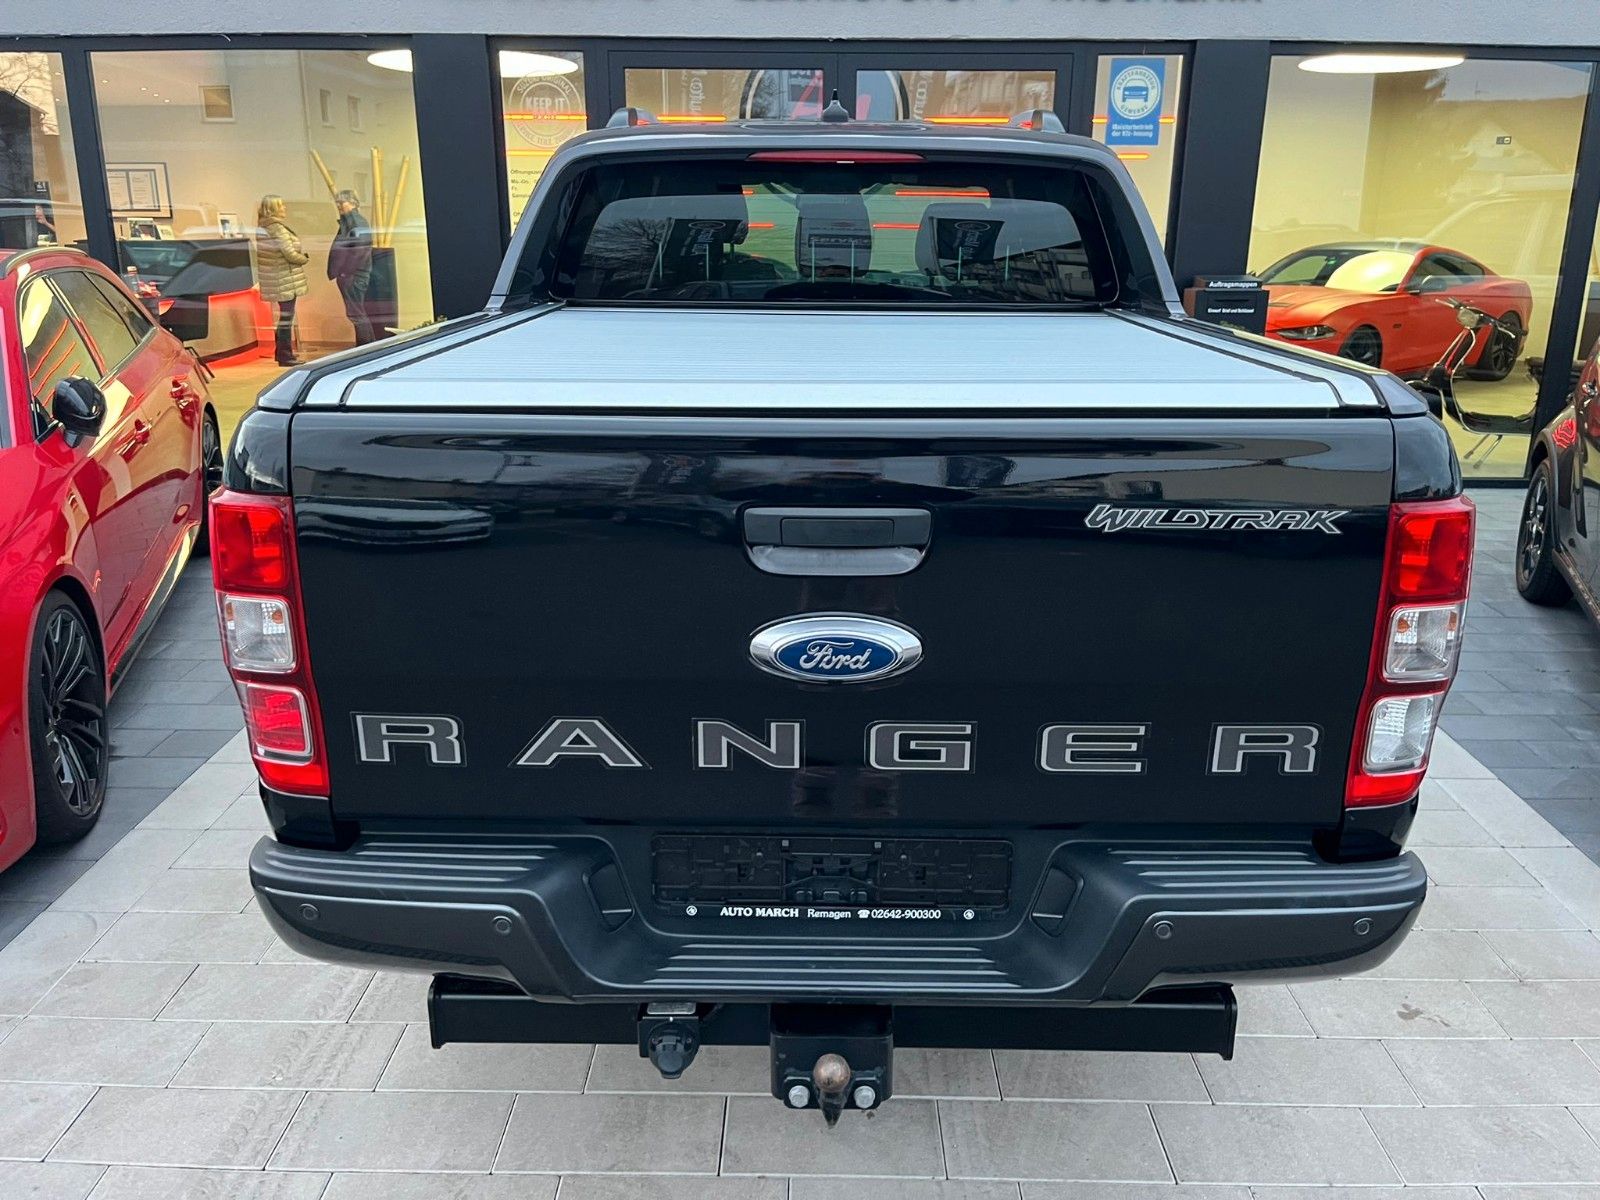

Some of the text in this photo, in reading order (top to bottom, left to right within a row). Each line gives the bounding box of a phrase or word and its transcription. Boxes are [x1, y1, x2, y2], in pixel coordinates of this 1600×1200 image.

[525, 96, 552, 113] KEEP
[1084, 504, 1349, 535] WILDTRAK
[799, 640, 871, 670] Ford
[353, 711, 1321, 775] RANGER
[720, 907, 942, 920] AUTO MARCH Remagen 02642-900300
